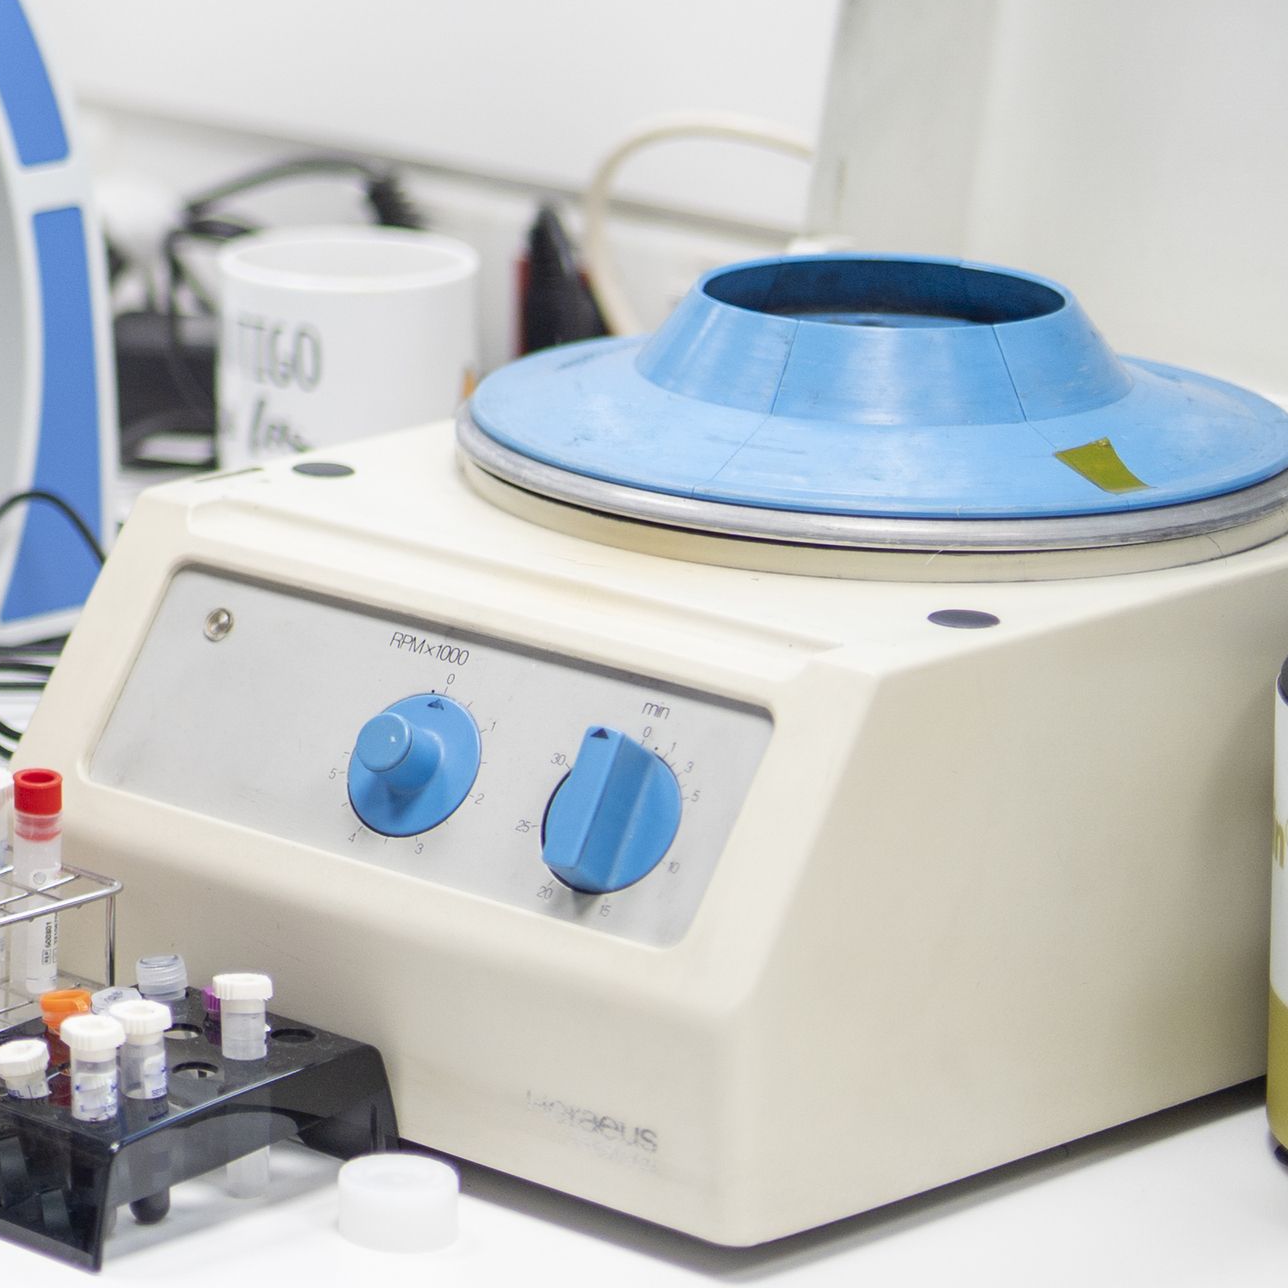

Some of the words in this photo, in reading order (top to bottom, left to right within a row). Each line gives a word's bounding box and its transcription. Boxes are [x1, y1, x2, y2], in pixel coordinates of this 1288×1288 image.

[389, 631, 471, 667] RPMx1000
[446, 673, 456, 685] 0
[641, 701, 671, 720] min
[489, 720, 498, 733] 1
[642, 726, 653, 738] 0
[550, 752, 567, 766] 30
[328, 768, 338, 780] 5
[684, 761, 695, 774] 3
[474, 793, 485, 806] 2
[690, 789, 701, 803] 5
[515, 819, 531, 833] 25
[347, 832, 357, 844] 4
[414, 843, 425, 856] 3
[667, 861, 681, 875] 10
[536, 885, 553, 900] 20
[599, 904, 612, 918] 15
